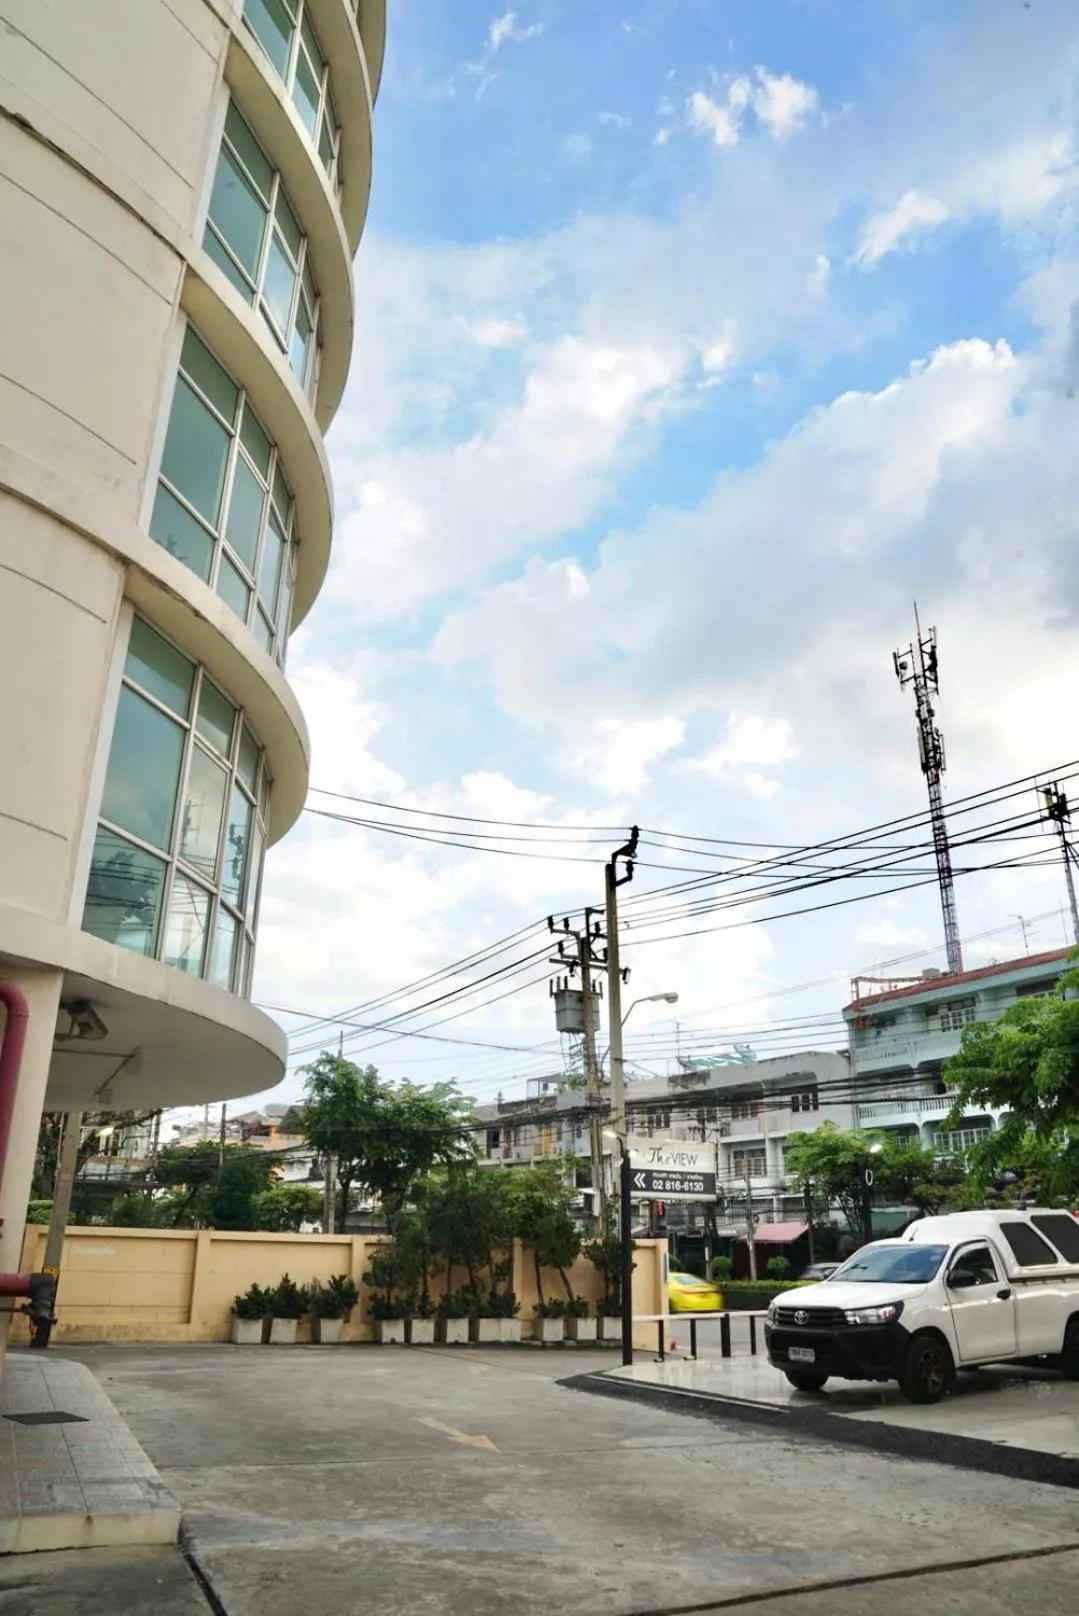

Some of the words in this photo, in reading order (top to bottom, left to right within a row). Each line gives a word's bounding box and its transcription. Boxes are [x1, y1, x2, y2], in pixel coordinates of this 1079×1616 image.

[648, 1146, 670, 1165] The
[670, 1151, 698, 1166] VIEW
[652, 1179, 664, 1190] 02
[665, 1180, 704, 1192] 816-6130
